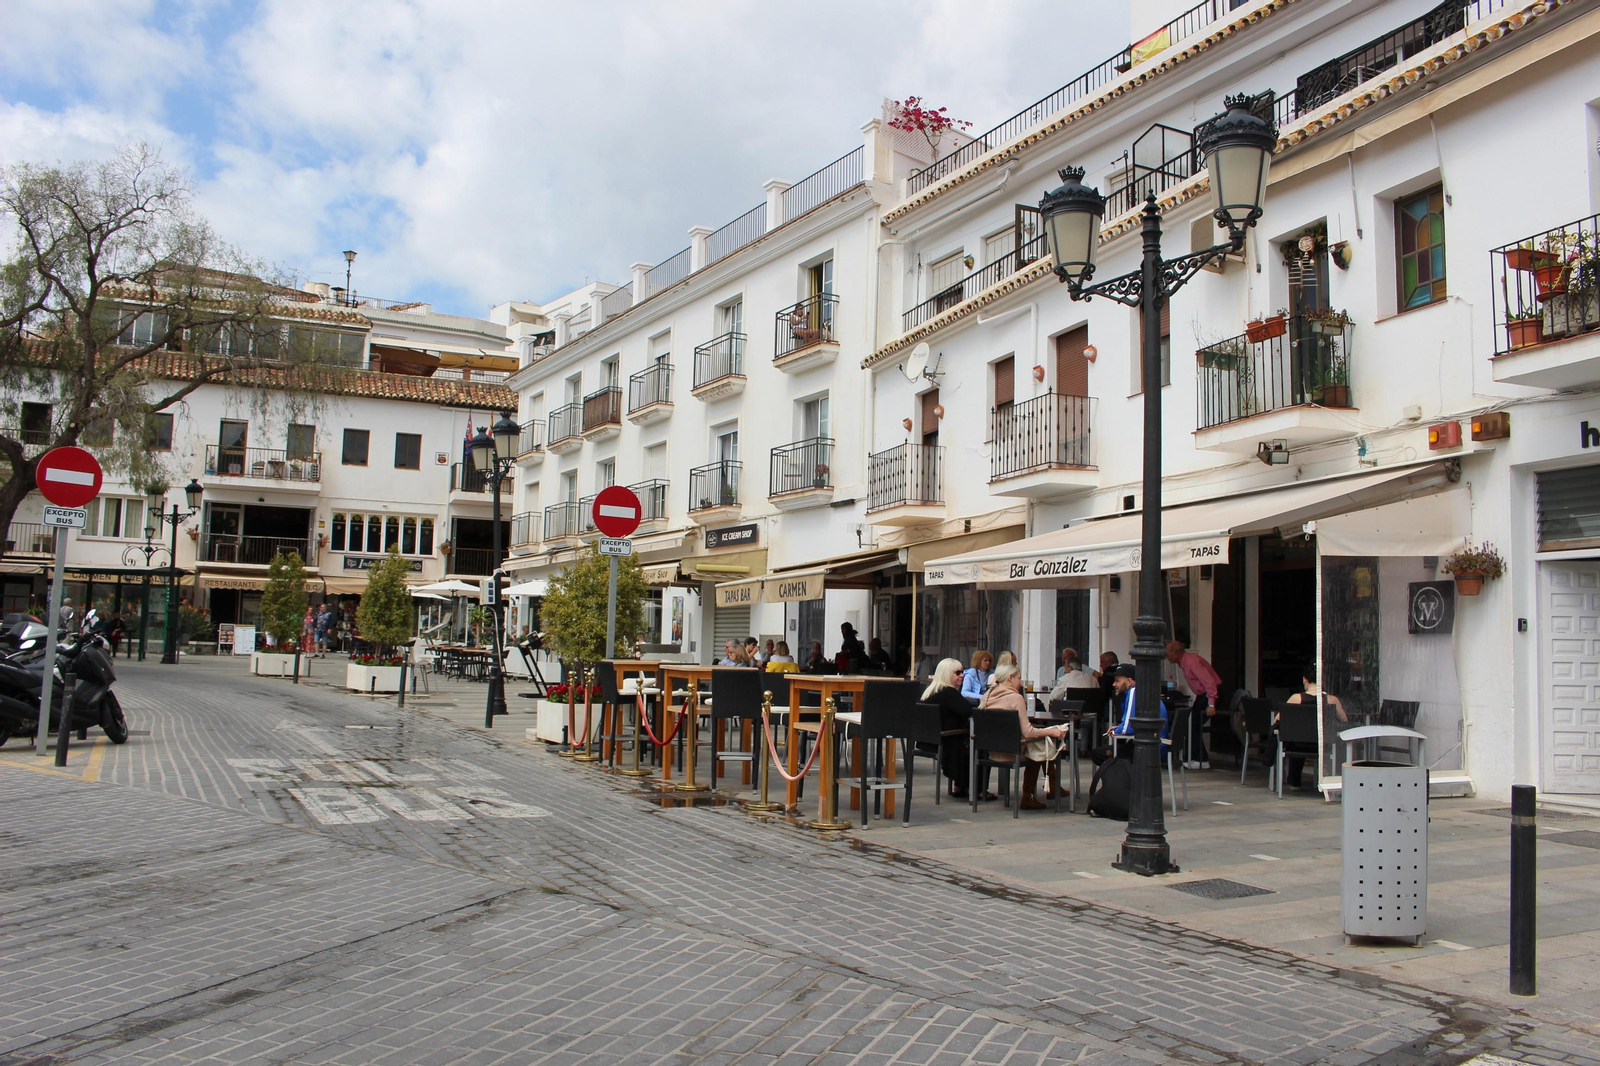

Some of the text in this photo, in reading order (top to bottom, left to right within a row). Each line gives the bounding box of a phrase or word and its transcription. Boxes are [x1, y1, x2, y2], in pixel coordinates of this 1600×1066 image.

[1581, 421, 1600, 448] h
[46, 508, 84, 518] EXCEPTO
[728, 531, 742, 540] CREAM
[741, 529, 753, 539] SHOP
[601, 539, 630, 547] EXCEPTO
[1190, 545, 1220, 558] TAPAS
[1009, 555, 1089, 579] Bar González
[929, 570, 945, 580] TAPAS
[204, 579, 257, 589] RESTAURANTE
[778, 581, 807, 598] CARMEN
[724, 587, 751, 603] TAPAS BAR
[288, 785, 554, 826] BUS
